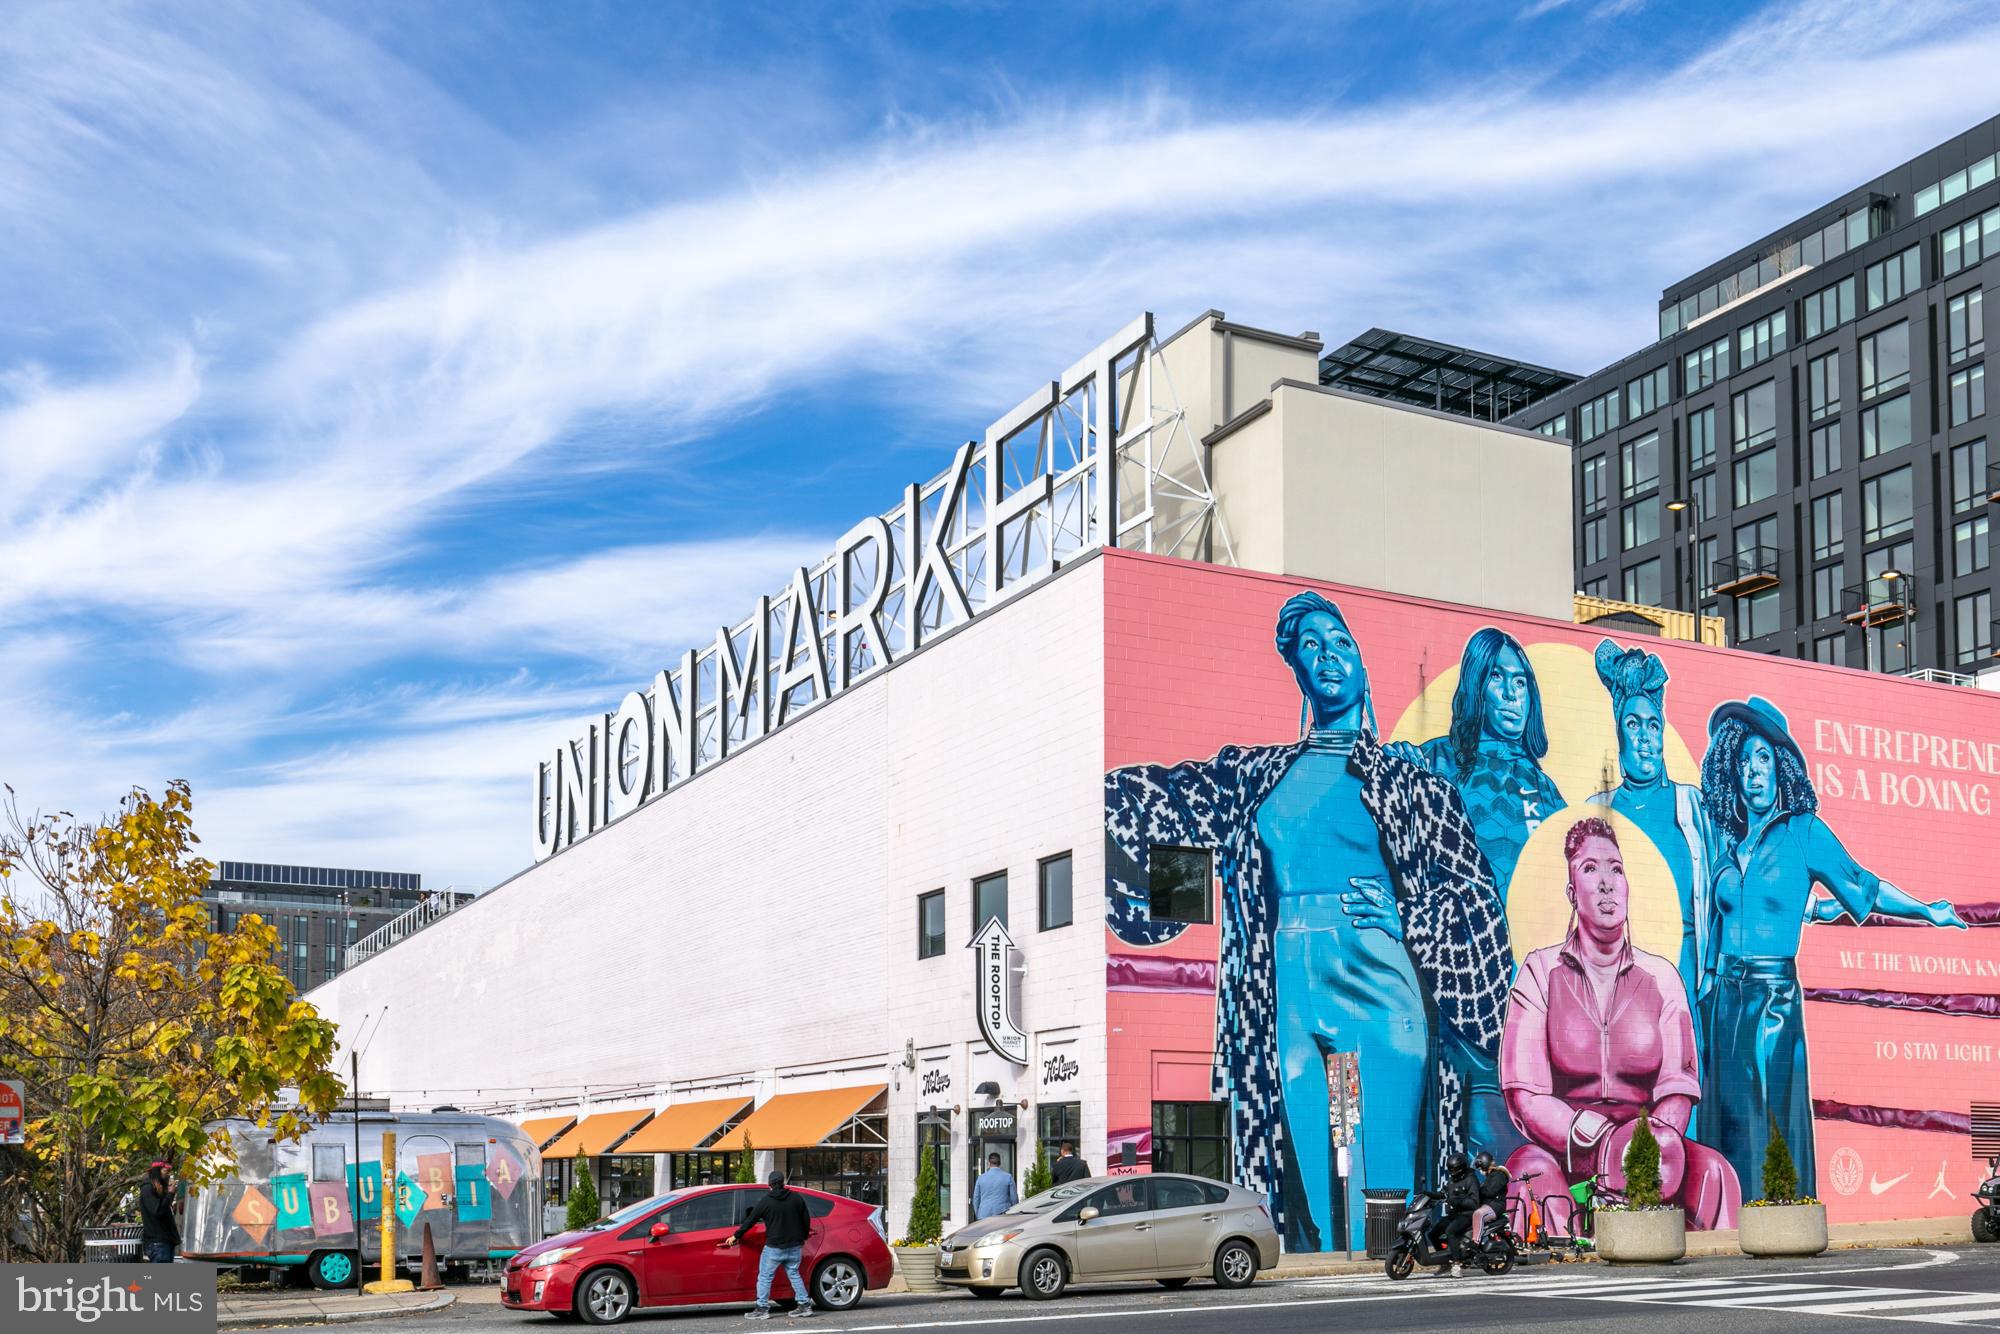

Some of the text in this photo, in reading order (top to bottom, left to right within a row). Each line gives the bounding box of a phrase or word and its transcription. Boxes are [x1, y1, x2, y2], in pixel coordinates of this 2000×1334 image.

[533, 311, 1153, 863] UNION MARKET
[1814, 718, 2000, 775] ENTREPRENE
[1815, 763, 1844, 798] IS
[1852, 768, 1871, 801] A
[1880, 772, 1991, 816] BOXING
[991, 934, 1001, 1030] THE ROOFTOP
[1840, 951, 2000, 978] WE THE WOMEN KN
[1873, 1041, 1898, 1060] TO
[1903, 1042, 1939, 1061] STAY
[1945, 1043, 1992, 1063] LIGHT
[0, 1093, 14, 1104] OT
[979, 1117, 1014, 1129] ROOFTOP
